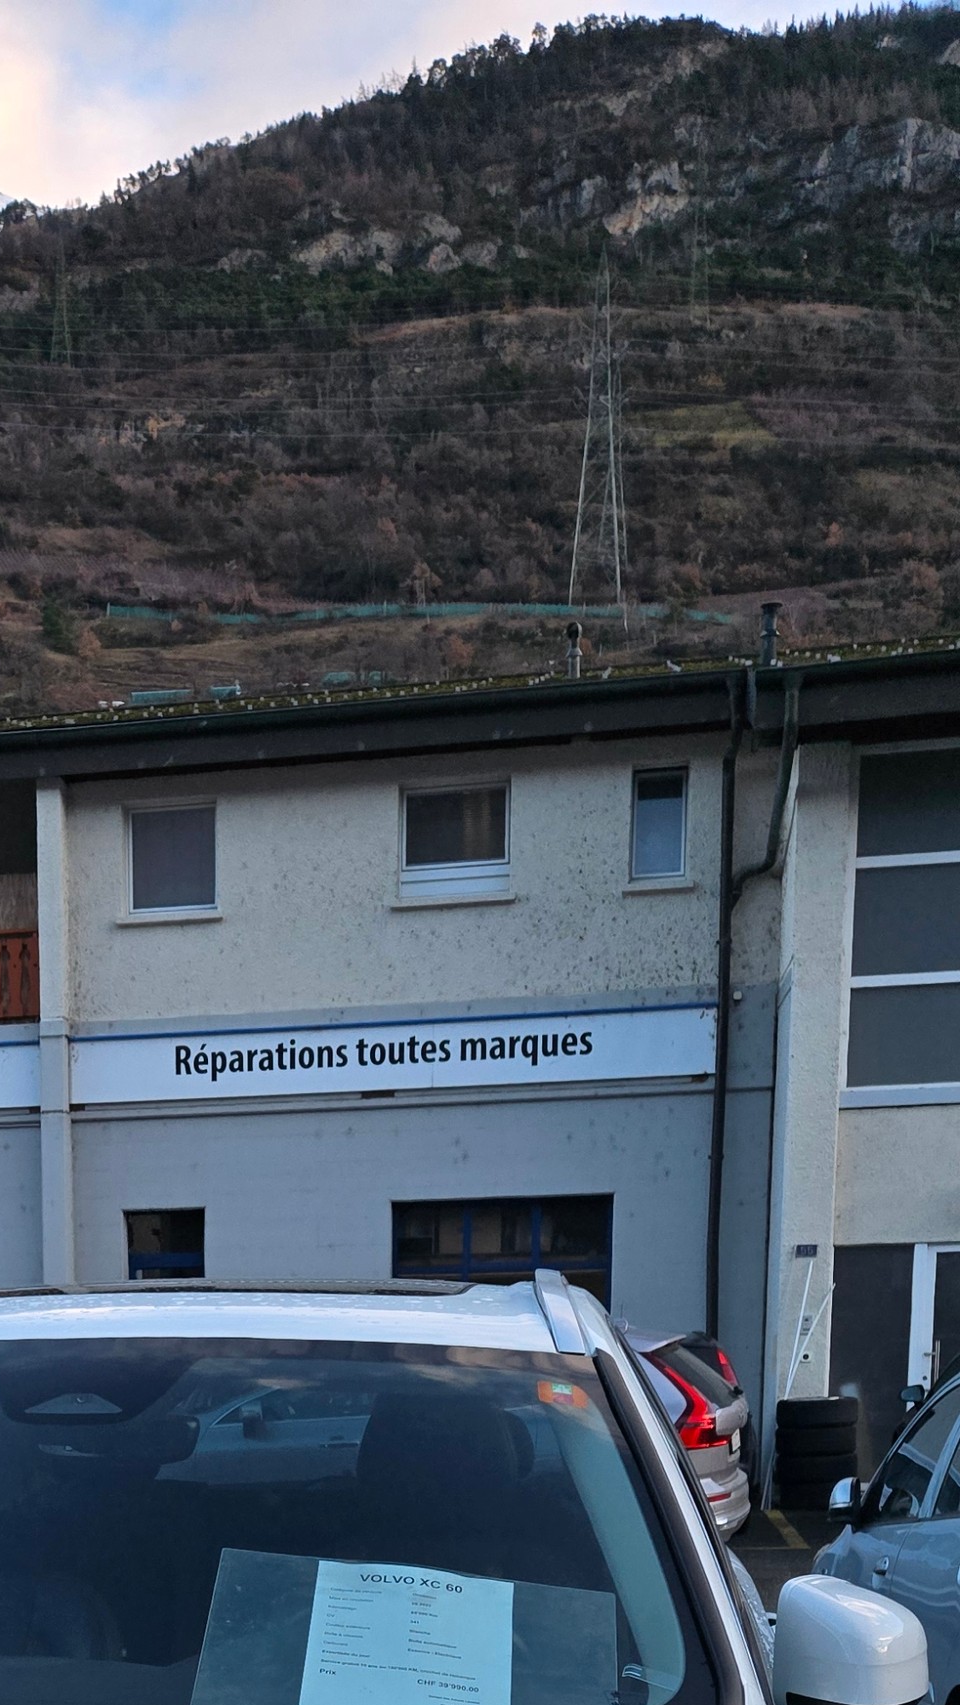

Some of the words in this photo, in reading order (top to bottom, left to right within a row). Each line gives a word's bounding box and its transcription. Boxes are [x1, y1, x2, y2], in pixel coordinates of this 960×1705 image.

[175, 1039, 348, 1081] Réparations
[356, 1036, 451, 1066] toutes
[460, 1031, 593, 1066] marques
[360, 1573, 415, 1585] VOLVO
[420, 1577, 441, 1589] XC
[445, 1583, 463, 1594] 60
[319, 1668, 337, 1676] Prix
[417, 1678, 436, 1686] CHF
